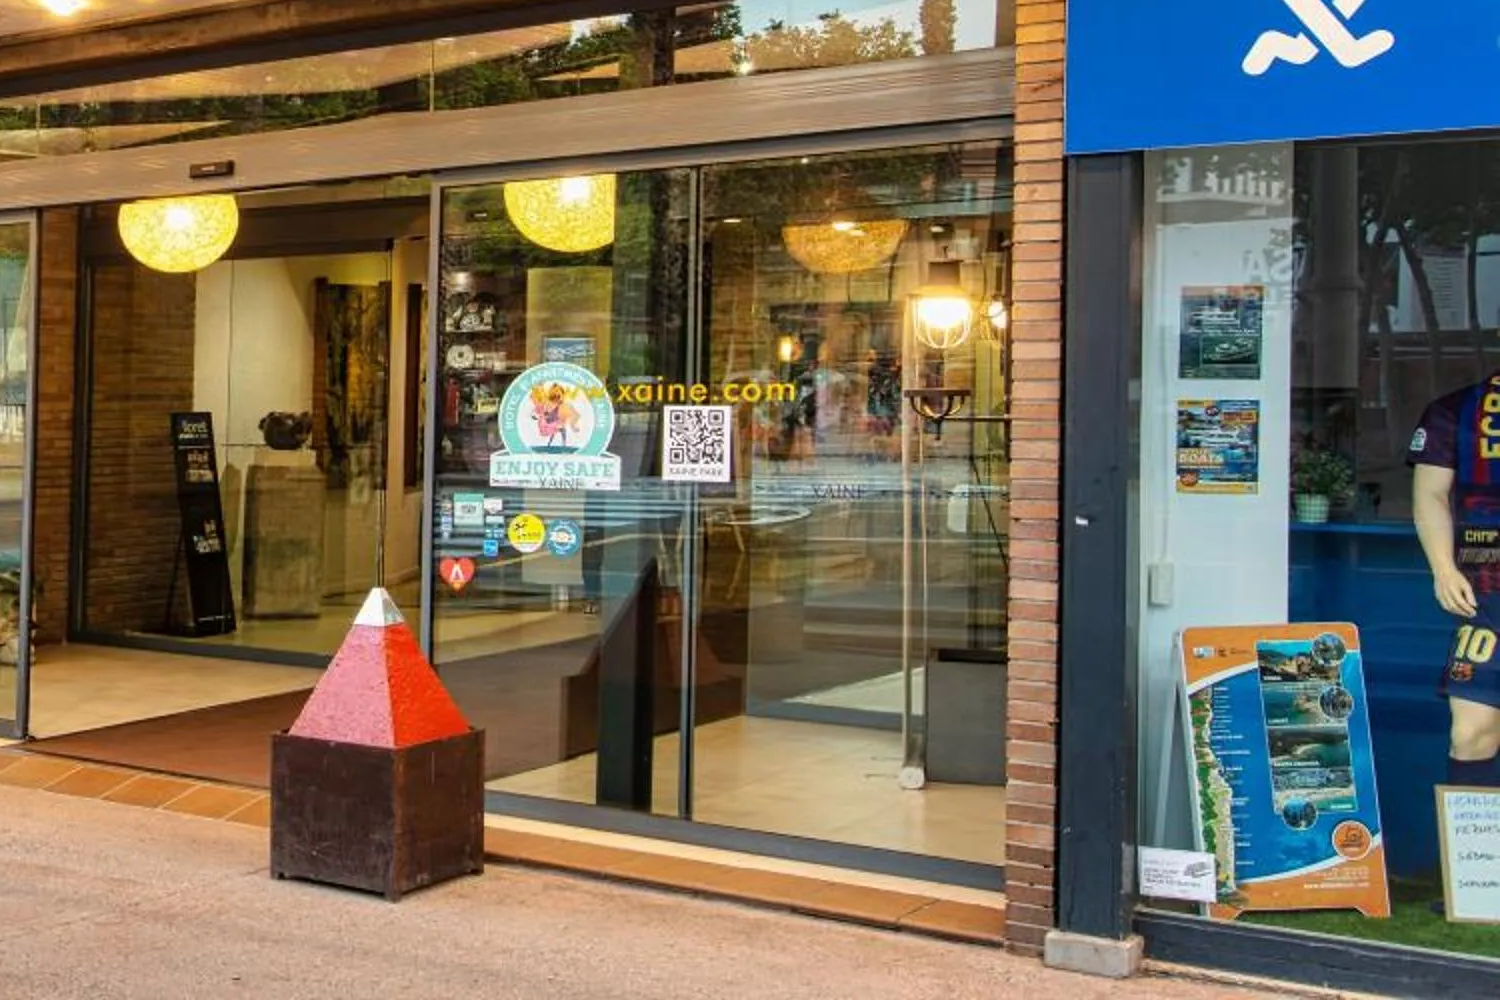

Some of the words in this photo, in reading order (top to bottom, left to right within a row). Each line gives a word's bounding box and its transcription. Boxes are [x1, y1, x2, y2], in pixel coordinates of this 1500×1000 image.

[496, 460, 558, 476] ENJOY
[563, 461, 614, 477] SAFE
[1454, 625, 1497, 663] 10
